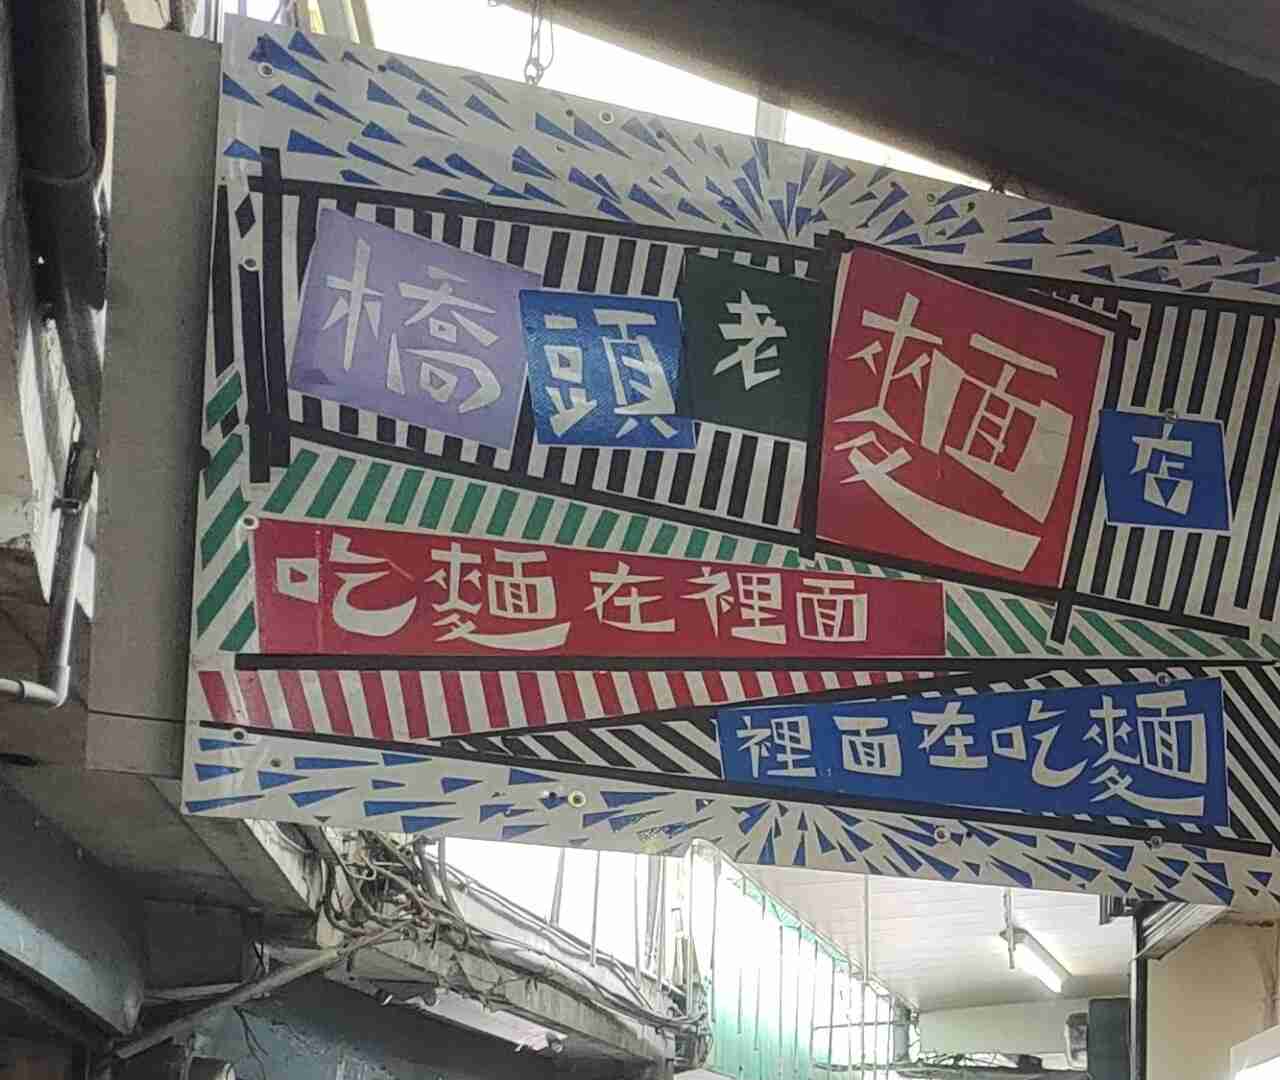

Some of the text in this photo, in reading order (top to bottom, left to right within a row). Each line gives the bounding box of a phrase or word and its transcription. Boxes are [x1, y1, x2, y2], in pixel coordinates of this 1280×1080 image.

[322, 237, 1193, 573] 橋頭老麵店
[276, 534, 869, 652] 吃麵在裡面
[737, 676, 1207, 816] 裡面在吃麵
